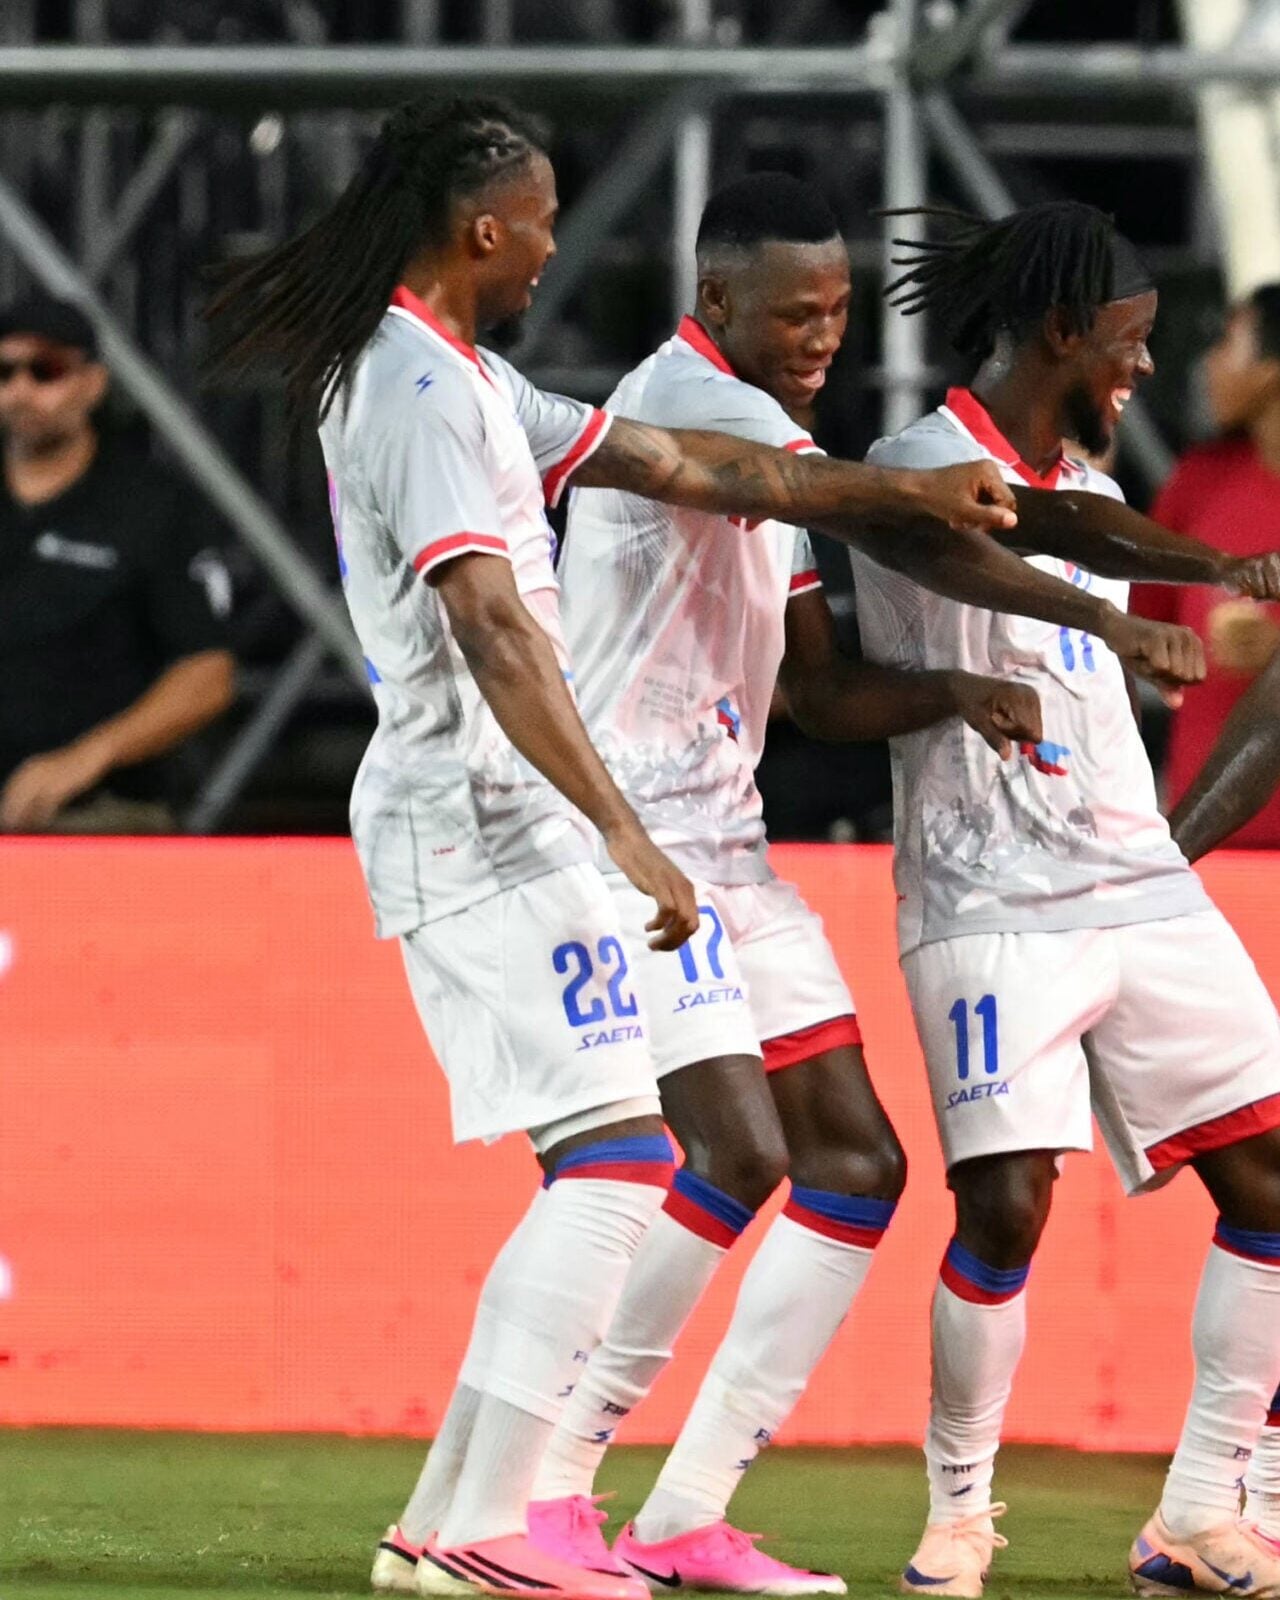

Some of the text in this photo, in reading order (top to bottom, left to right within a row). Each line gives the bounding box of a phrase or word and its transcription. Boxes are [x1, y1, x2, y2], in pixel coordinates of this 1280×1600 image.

[552, 935, 638, 1027] 22
[673, 987, 744, 1013] SAETA
[576, 1025, 644, 1051] SAETA
[948, 993, 998, 1080] 11
[945, 1081, 1010, 1111] SAETA
